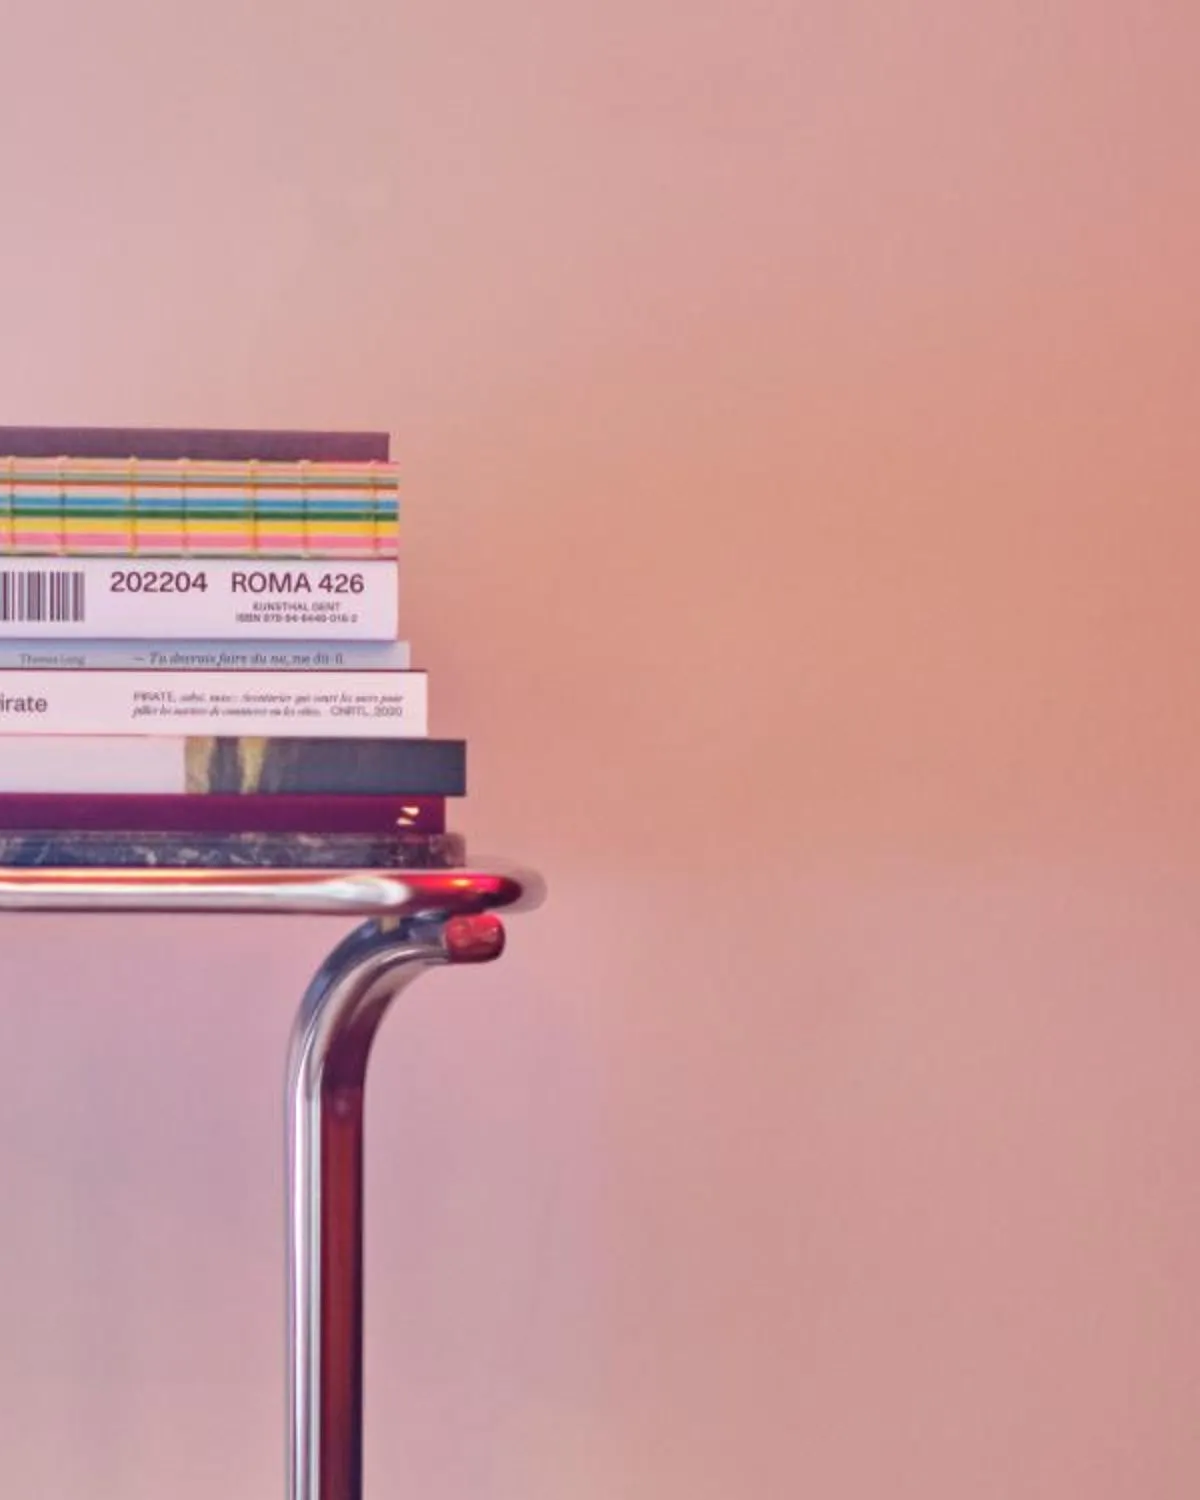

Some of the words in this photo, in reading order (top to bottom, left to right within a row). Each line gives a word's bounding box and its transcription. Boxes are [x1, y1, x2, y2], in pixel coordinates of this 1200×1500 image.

[109, 571, 209, 593] 202204
[231, 572, 313, 593] ROMA
[317, 573, 365, 594] 426
